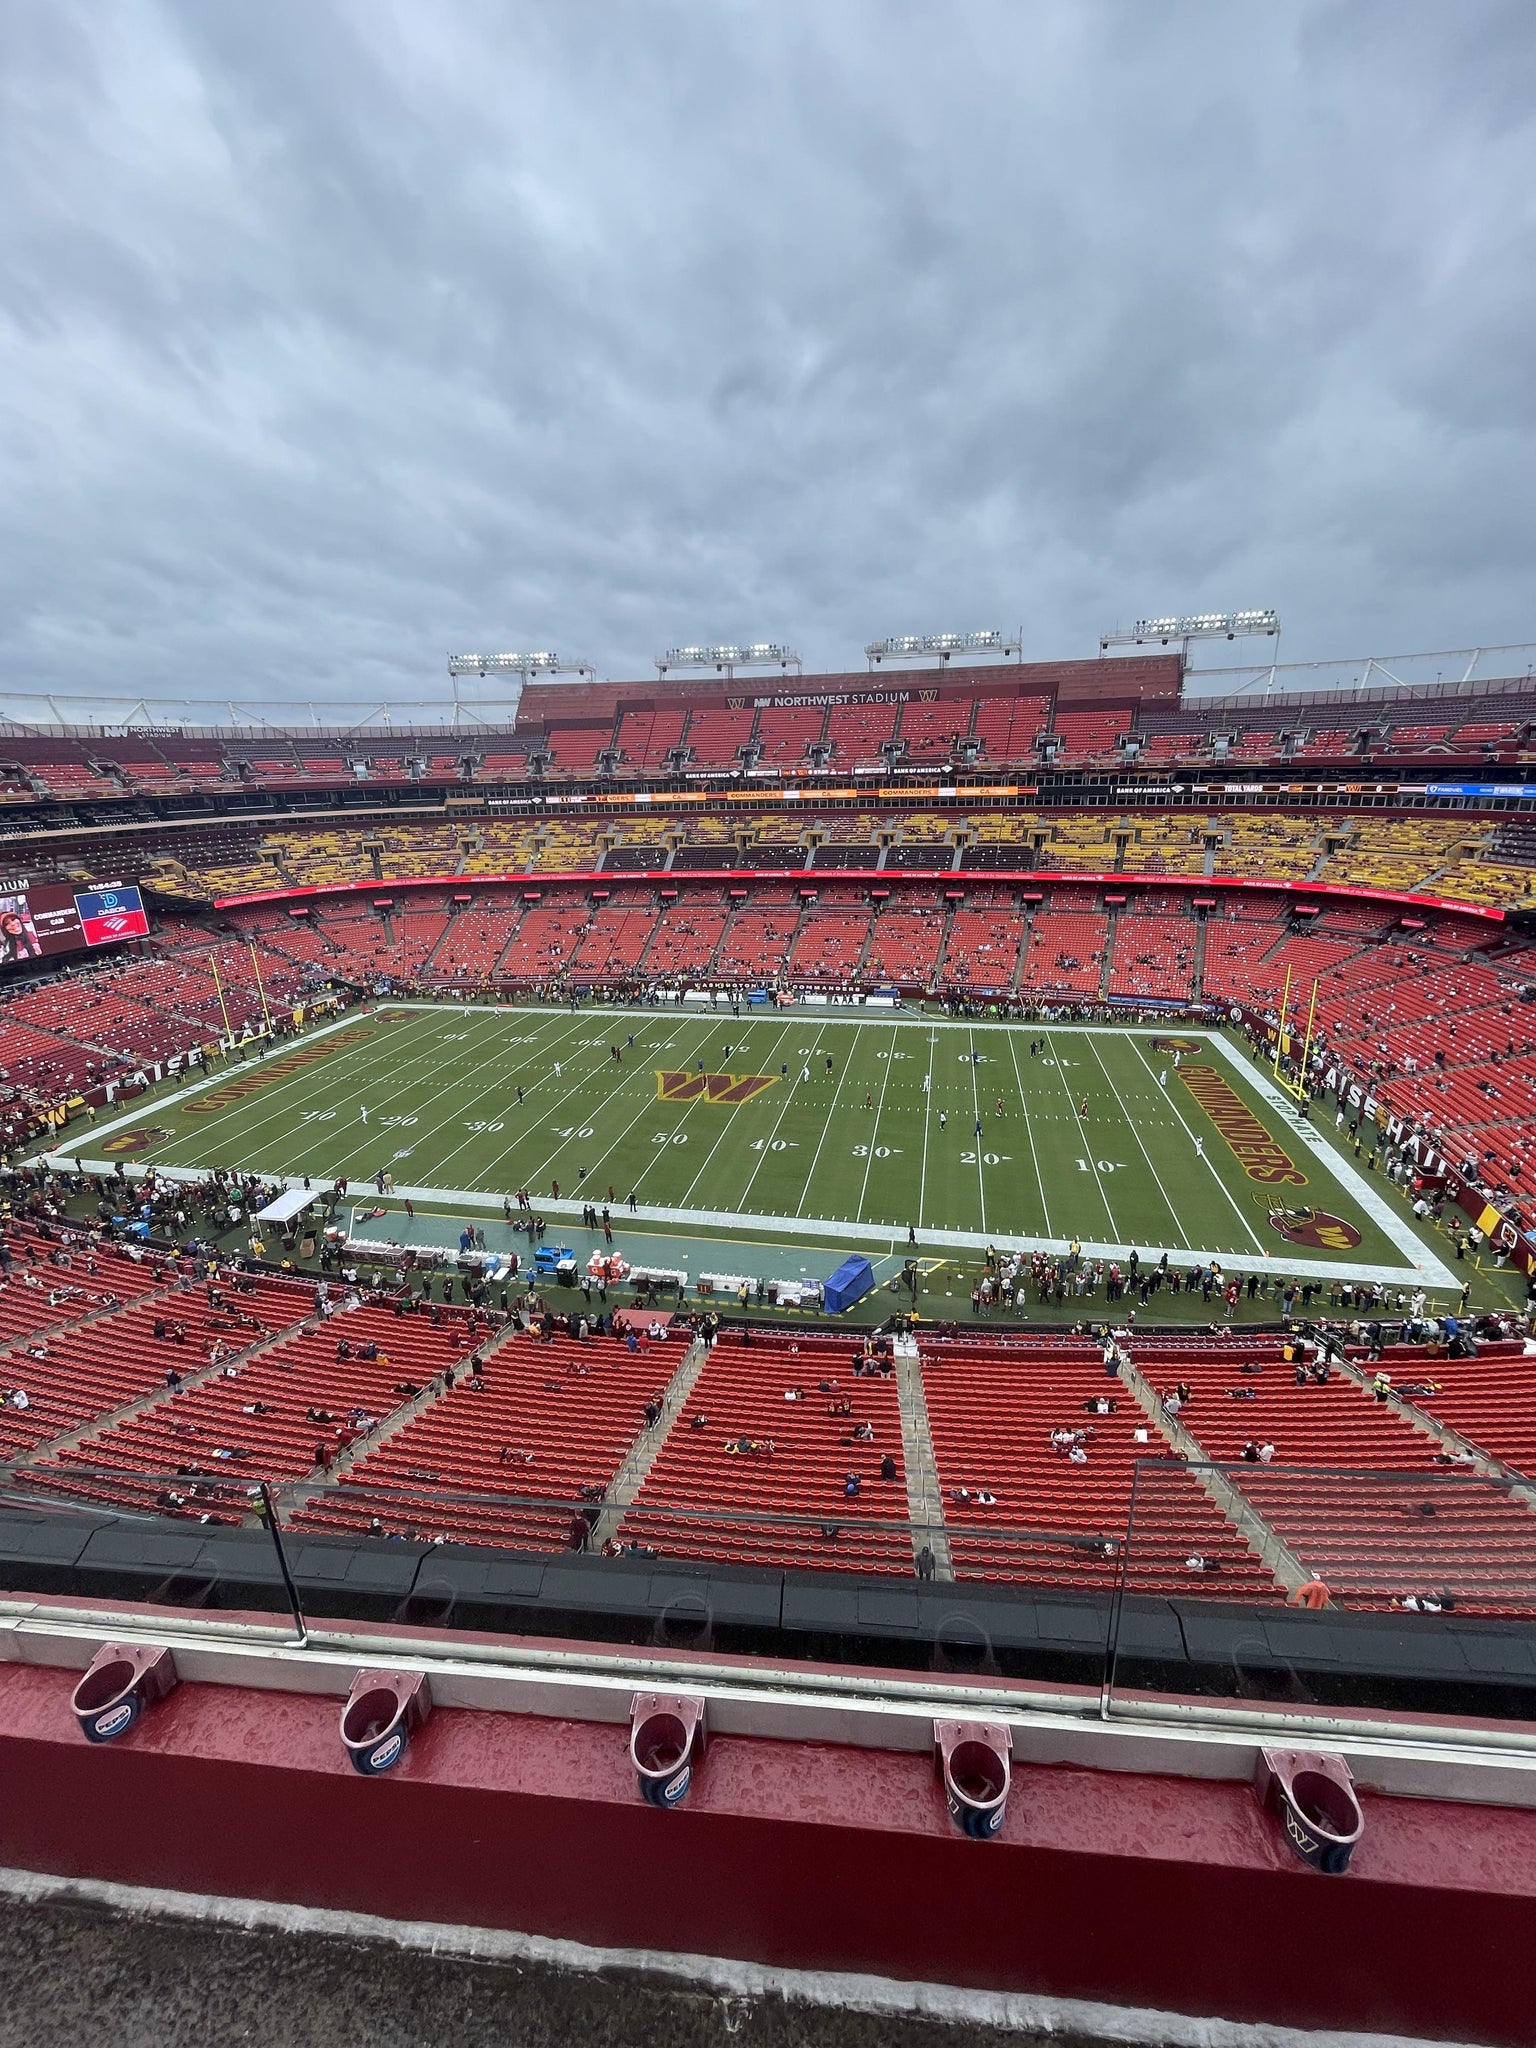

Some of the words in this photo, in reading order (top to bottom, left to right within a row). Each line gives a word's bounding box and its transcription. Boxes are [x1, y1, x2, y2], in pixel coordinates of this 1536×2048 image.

[774, 694, 850, 707] NORTHWEST
[851, 691, 910, 705] STADIUM
[1224, 784, 1243, 792] TOTAL
[1243, 784, 1263, 792] YARDS
[33, 908, 77, 921] COMMANDERS
[792, 984, 860, 992] COMMANDERS
[181, 1029, 376, 1114] COMMANDERS
[380, 1115, 419, 1127] 20
[467, 1120, 505, 1132] 30
[1172, 1064, 1309, 1186] COMMANDERS
[1266, 1095, 1298, 1117] STOP
[1288, 1117, 1323, 1144] HATE
[558, 1126, 594, 1139] 40
[650, 1132, 689, 1144] 50
[749, 1138, 787, 1151] 40
[851, 1144, 891, 1158] 30
[959, 1151, 1000, 1165] 20
[1074, 1158, 1115, 1174] 10
[97, 1707, 130, 1731] PEPSI
[372, 1739, 400, 1764] PEPSI
